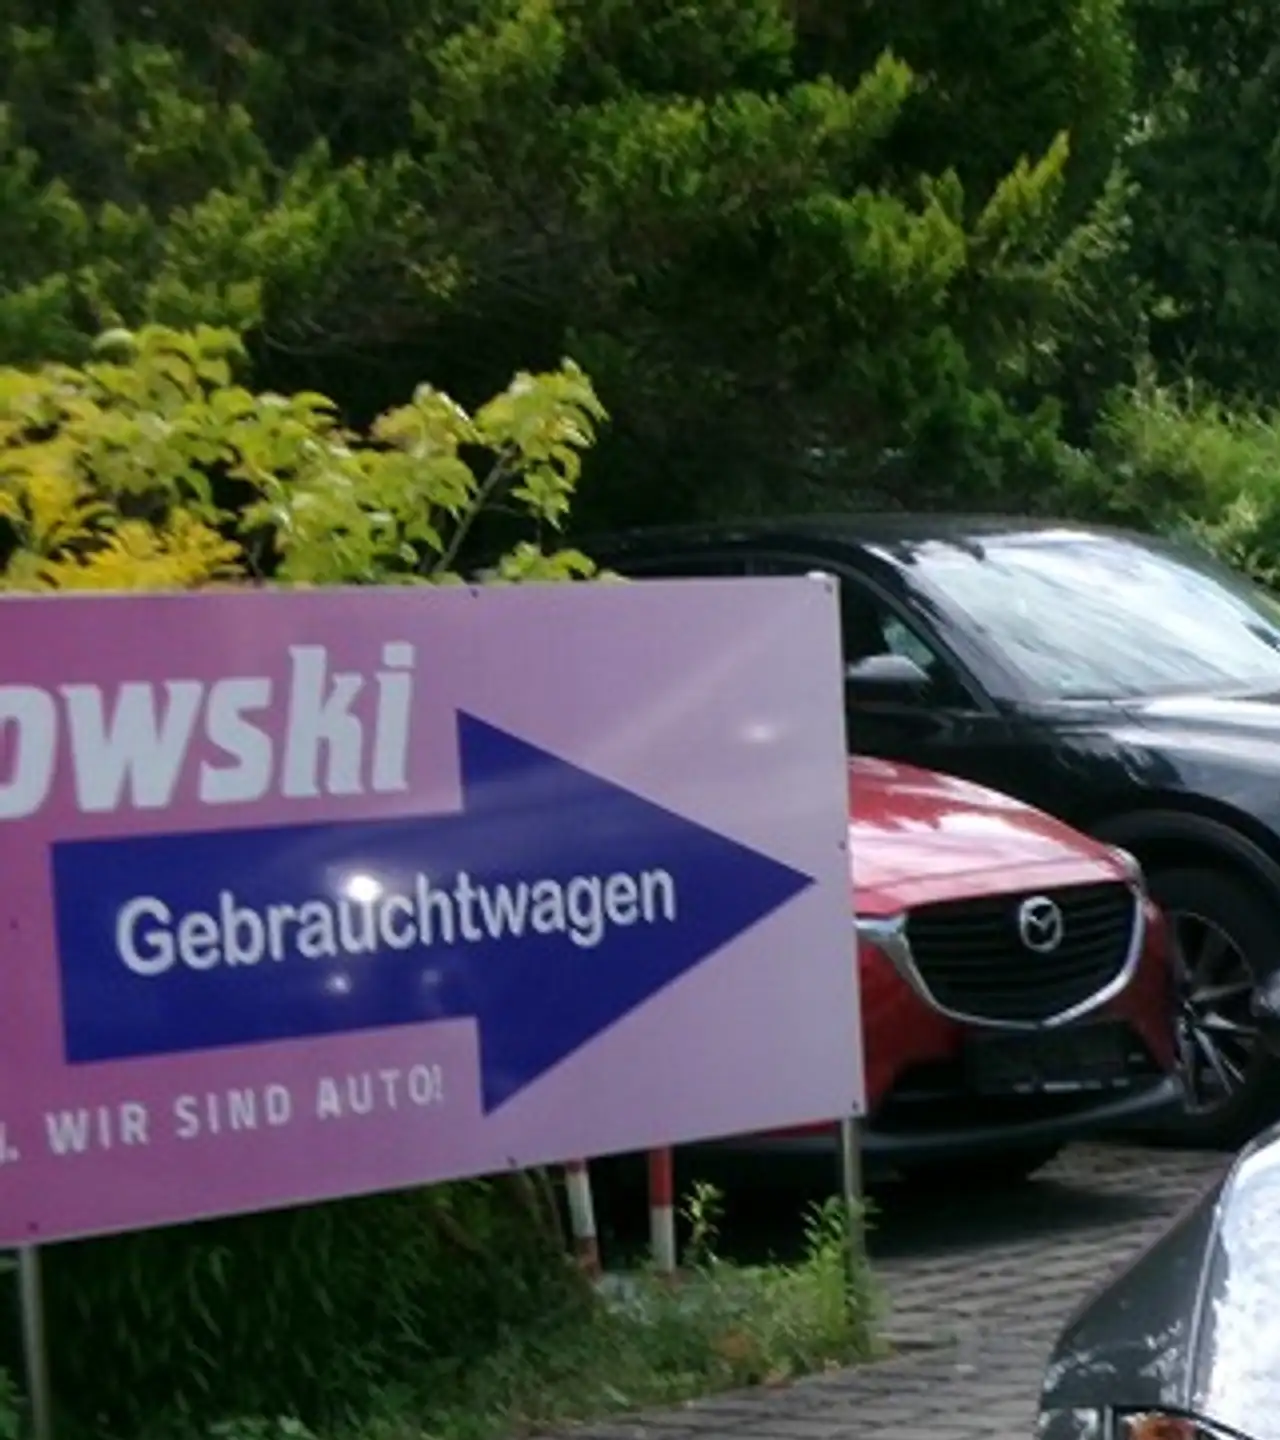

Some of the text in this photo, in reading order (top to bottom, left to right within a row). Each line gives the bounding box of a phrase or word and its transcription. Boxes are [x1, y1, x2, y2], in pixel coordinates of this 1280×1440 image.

[0, 641, 416, 820] owski
[116, 868, 677, 976] Gebrauchtwagen
[45, 1101, 149, 1155] WIR
[174, 1083, 292, 1141] SIND
[316, 1063, 445, 1119] AUTO!
